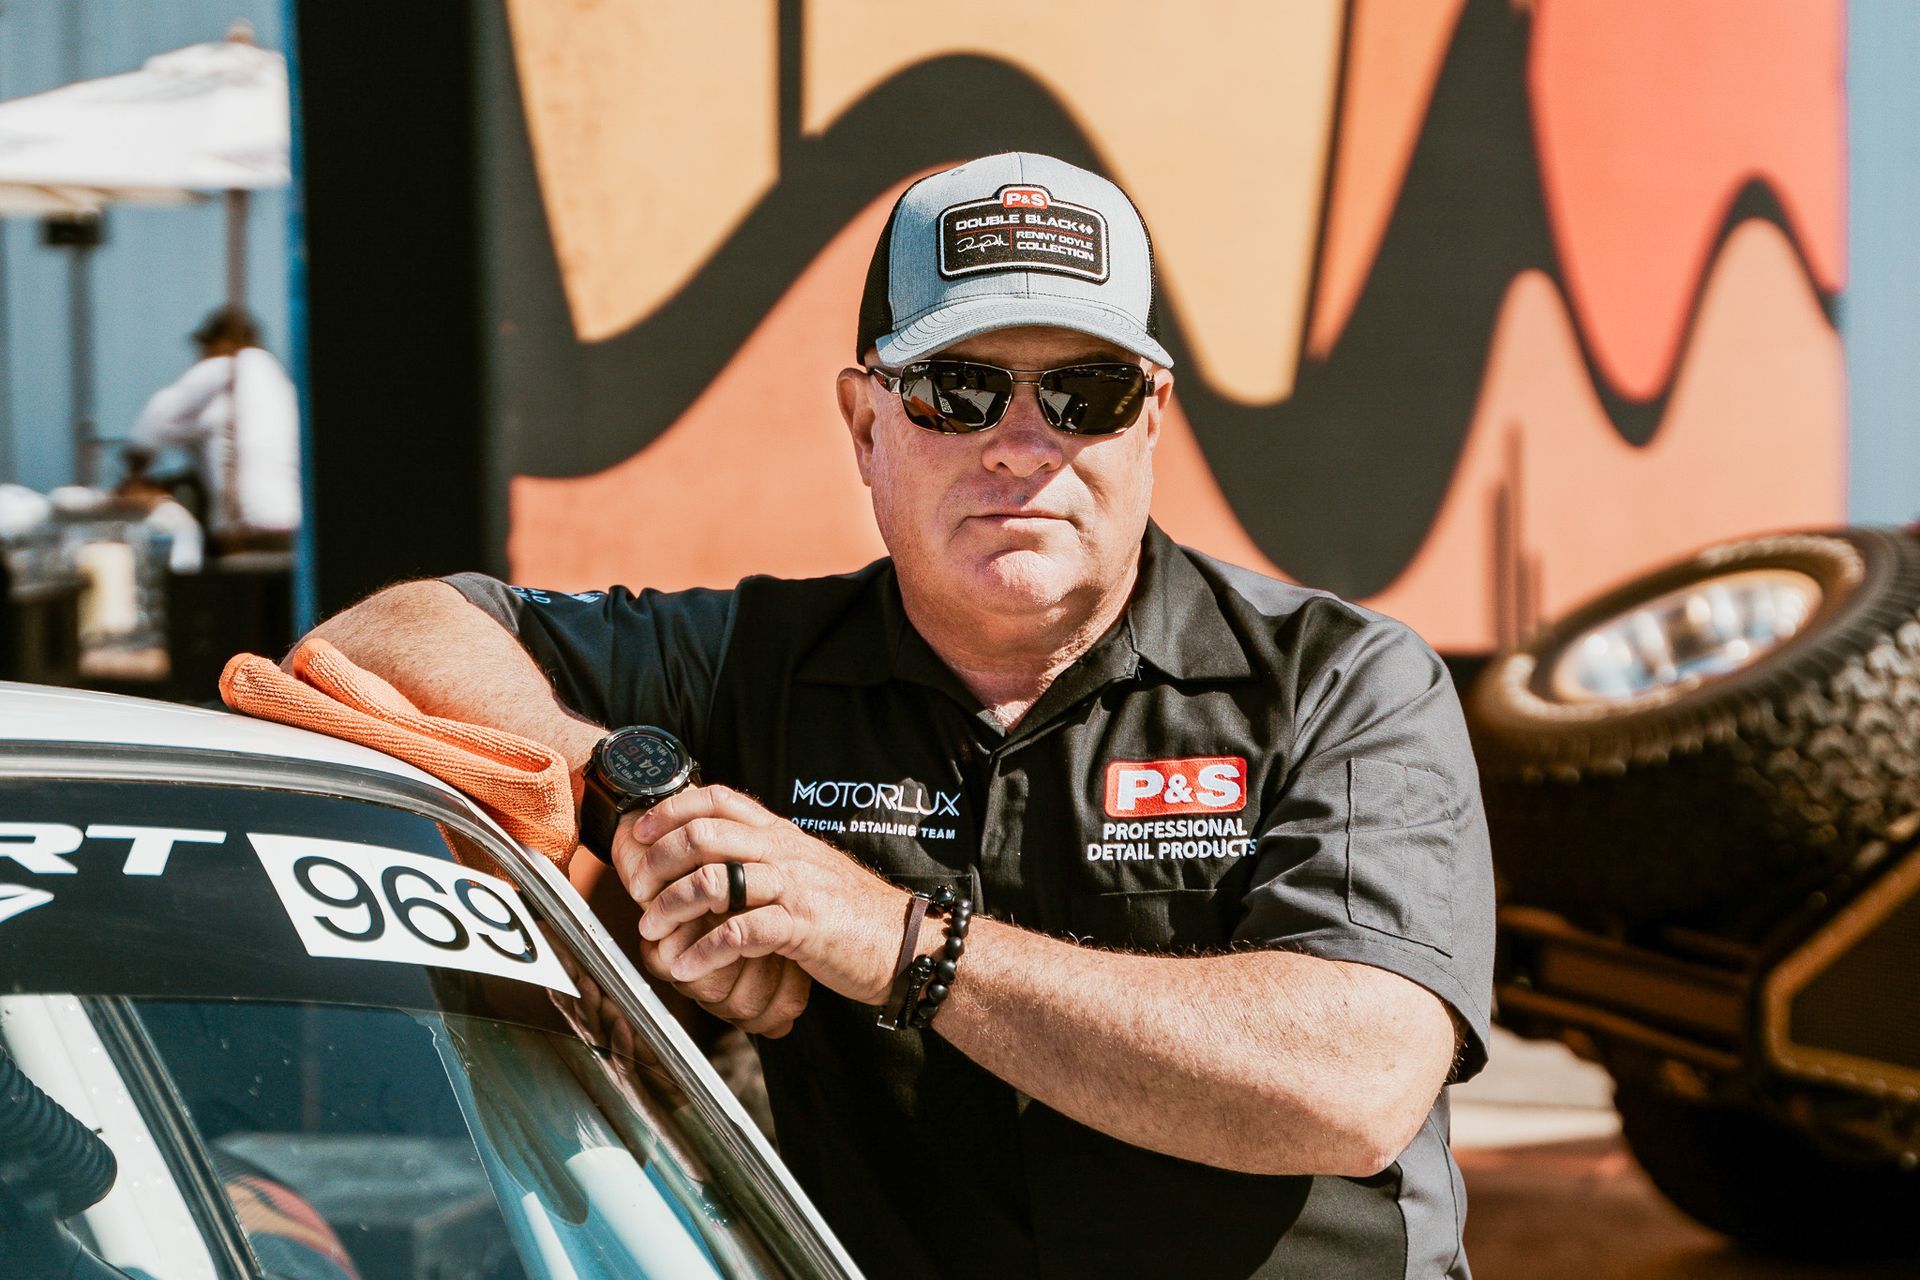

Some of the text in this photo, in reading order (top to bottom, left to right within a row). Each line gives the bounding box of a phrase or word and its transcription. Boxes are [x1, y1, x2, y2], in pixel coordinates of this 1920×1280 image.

[1005, 192, 1046, 207] P&S
[955, 213, 1079, 232] DOUBLE BLACK
[1016, 231, 1094, 250] RENNY DOYLE
[1016, 241, 1095, 262] COLLECTION
[792, 778, 961, 817] MOTORLUX
[1116, 763, 1242, 811] P&S
[791, 817, 956, 840] OFFICIAL DETAILING TEAM
[1103, 817, 1248, 841] PROFESSIONAL
[1087, 838, 1258, 862] DETAIL PRODUCTS
[293, 855, 538, 964] 969
